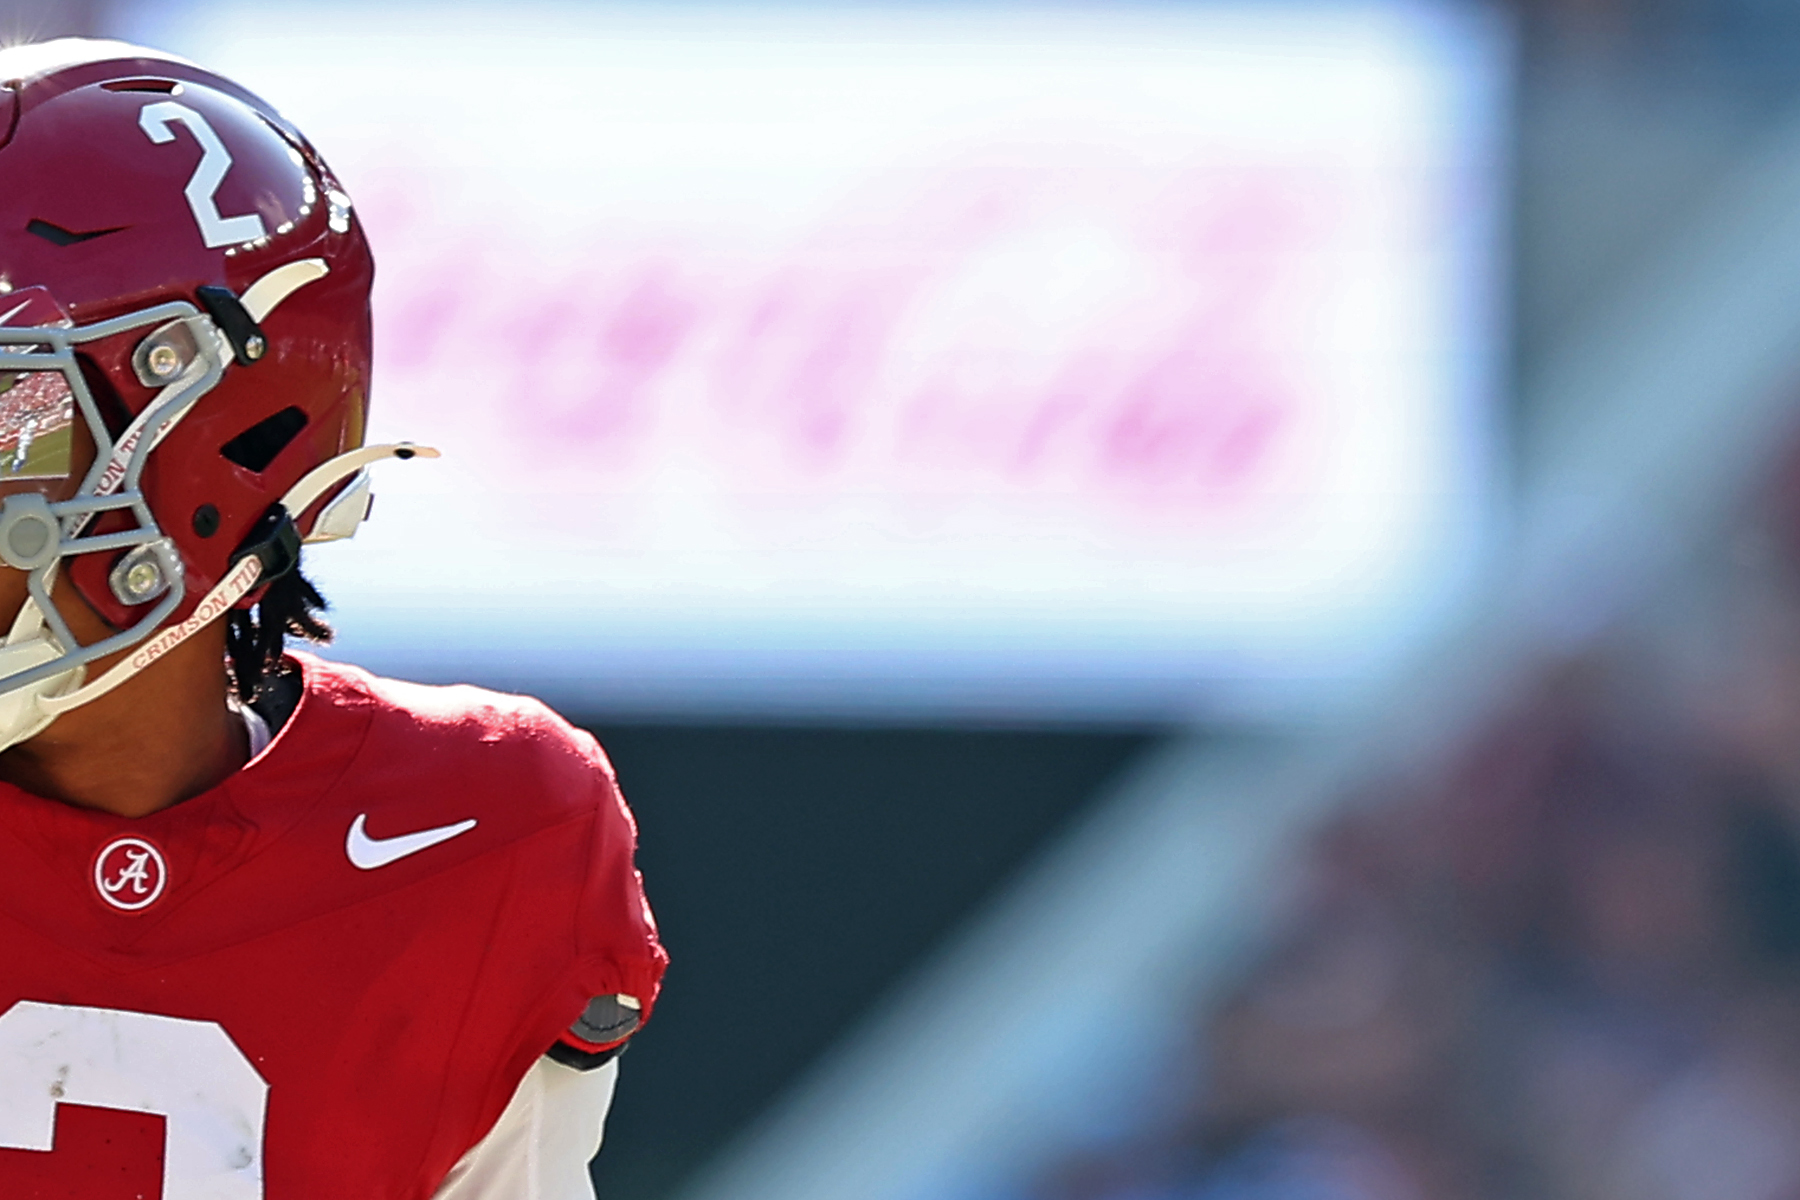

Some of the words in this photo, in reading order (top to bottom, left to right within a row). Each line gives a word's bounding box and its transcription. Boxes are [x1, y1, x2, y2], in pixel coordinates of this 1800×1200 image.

[138, 101, 268, 248] 2
[131, 589, 229, 670] CRIMSON
[104, 849, 149, 894] A
